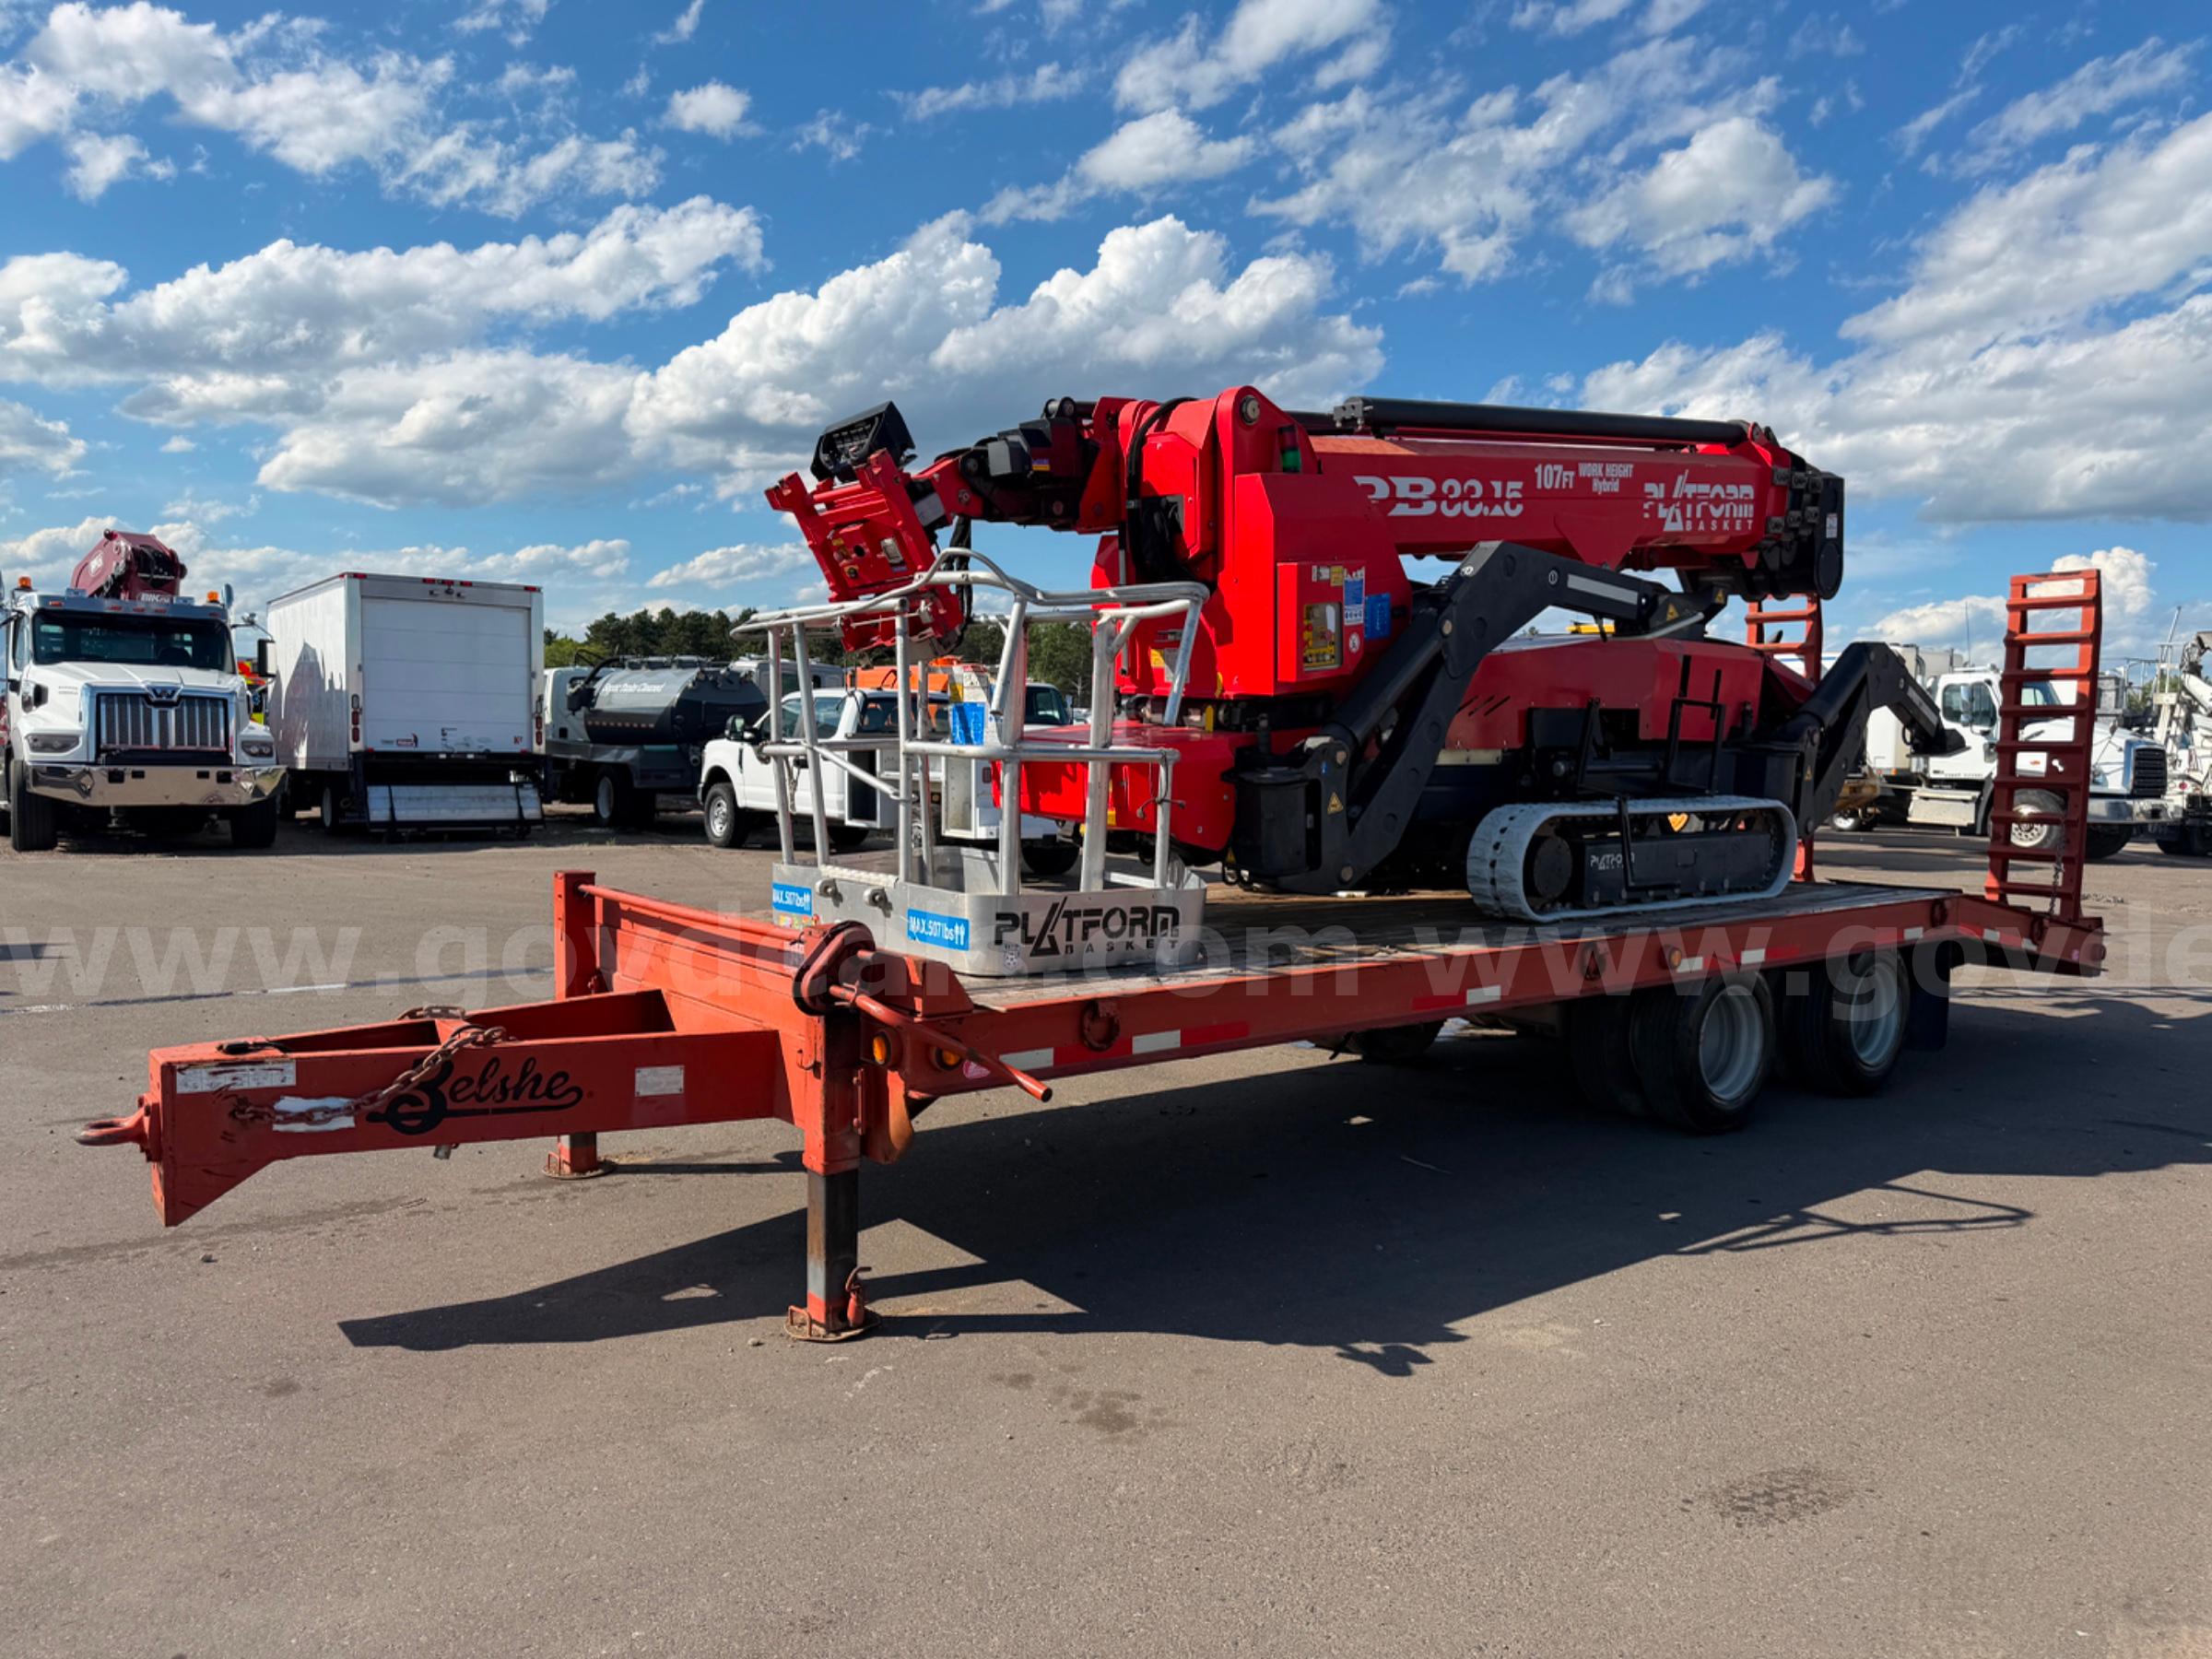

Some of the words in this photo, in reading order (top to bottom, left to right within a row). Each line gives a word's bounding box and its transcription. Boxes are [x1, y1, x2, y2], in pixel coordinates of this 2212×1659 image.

[1578, 463, 1604, 477] WORK
[1606, 463, 1633, 478] HEIGHT
[1593, 477, 1619, 495] Hybrid
[1643, 469, 1755, 531] PLATFORM
[1685, 519, 1754, 531] BASKET
[994, 896, 1180, 957] PLATFORM
[1065, 938, 1180, 955] BASKET
[366, 1056, 583, 1135] Belshe
